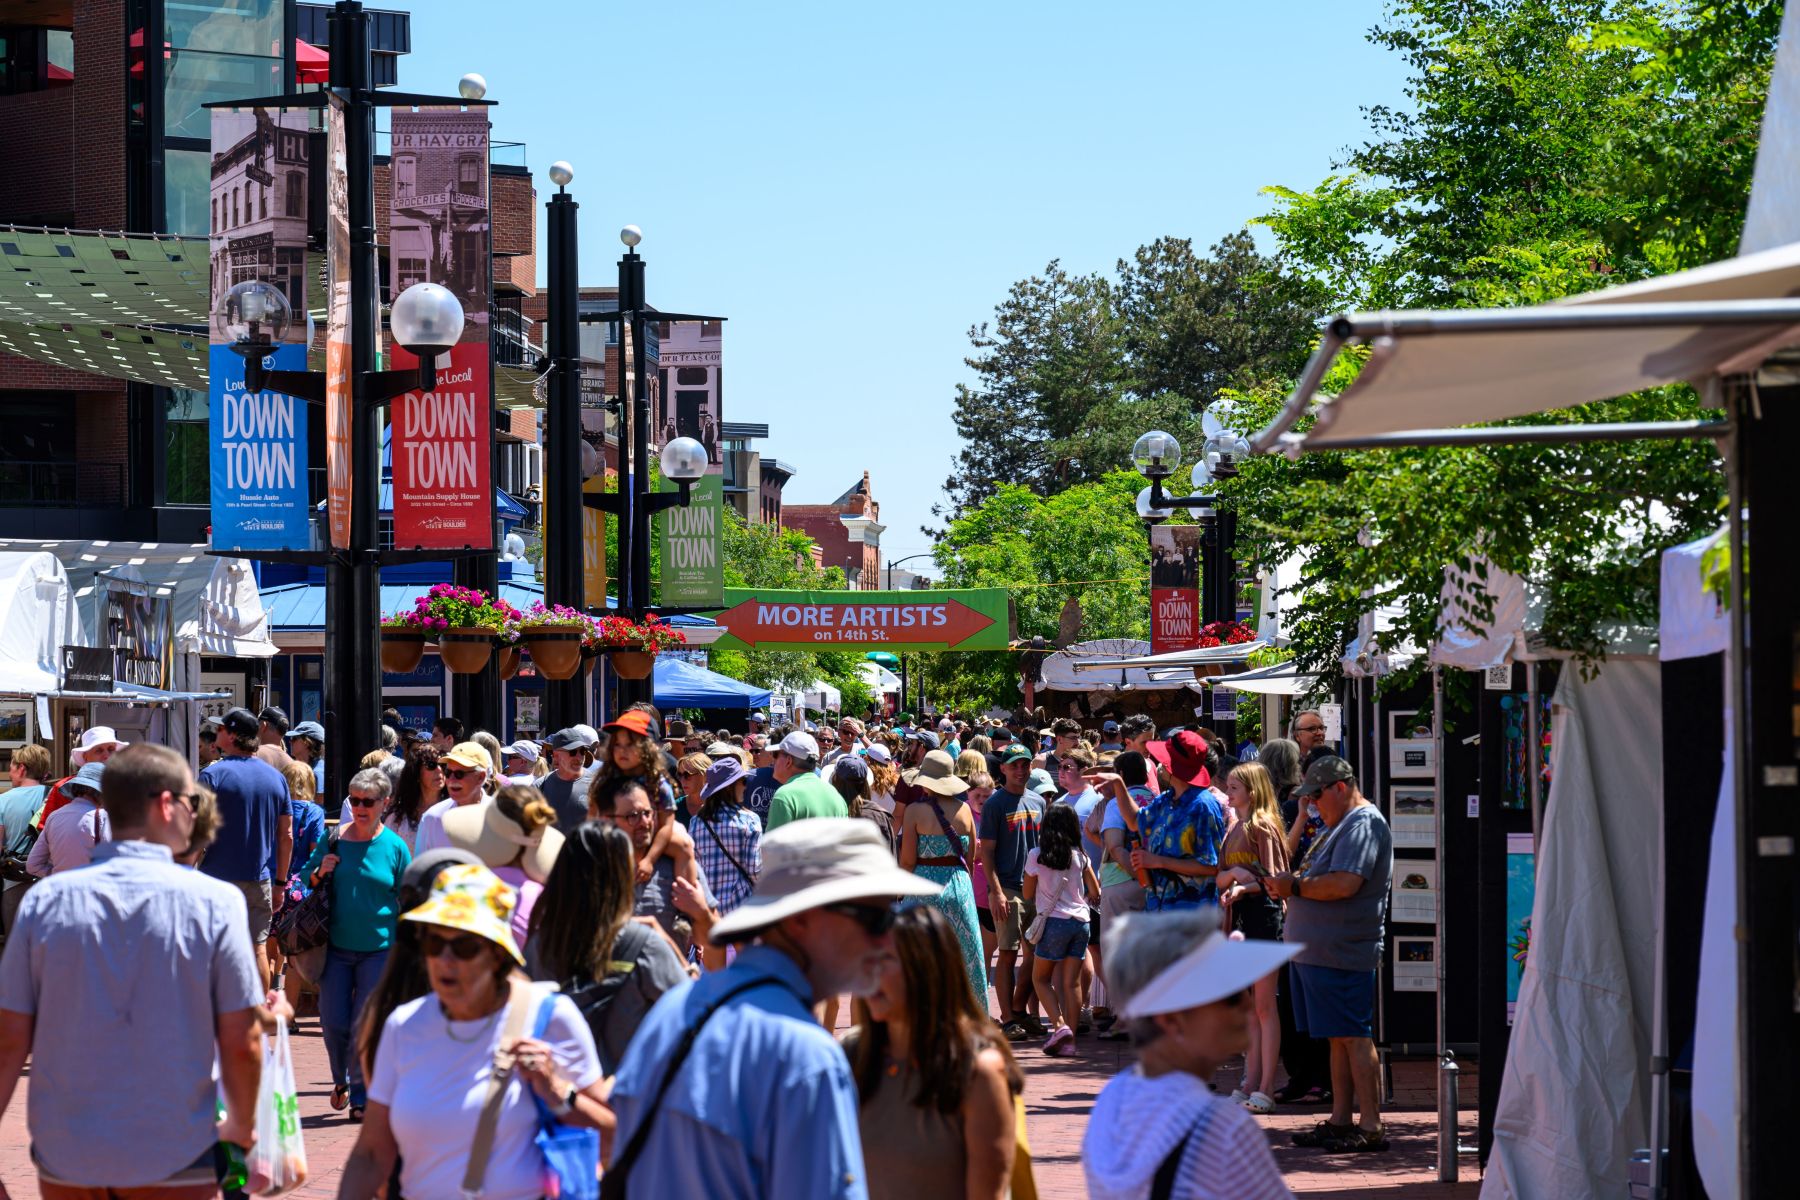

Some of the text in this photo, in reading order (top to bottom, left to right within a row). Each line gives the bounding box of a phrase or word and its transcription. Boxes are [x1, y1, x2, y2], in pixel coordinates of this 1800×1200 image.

[393, 193, 446, 209] GROCERIES
[234, 254, 257, 265] TIRES
[445, 367, 473, 385] Local
[223, 393, 294, 439] DOWN
[404, 392, 476, 438] DOWN
[221, 441, 295, 489] TOWN
[403, 441, 477, 489] TOWN
[436, 493, 459, 501] Supply
[668, 506, 715, 536] DOWN
[668, 537, 715, 568] TOWN
[757, 605, 947, 627] MORE ARTISTS
[1159, 601, 1192, 618] DOWN
[813, 629, 890, 641] on 14th St.
[1159, 618, 1192, 636] TOWN
[401, 716, 428, 725] PICK
